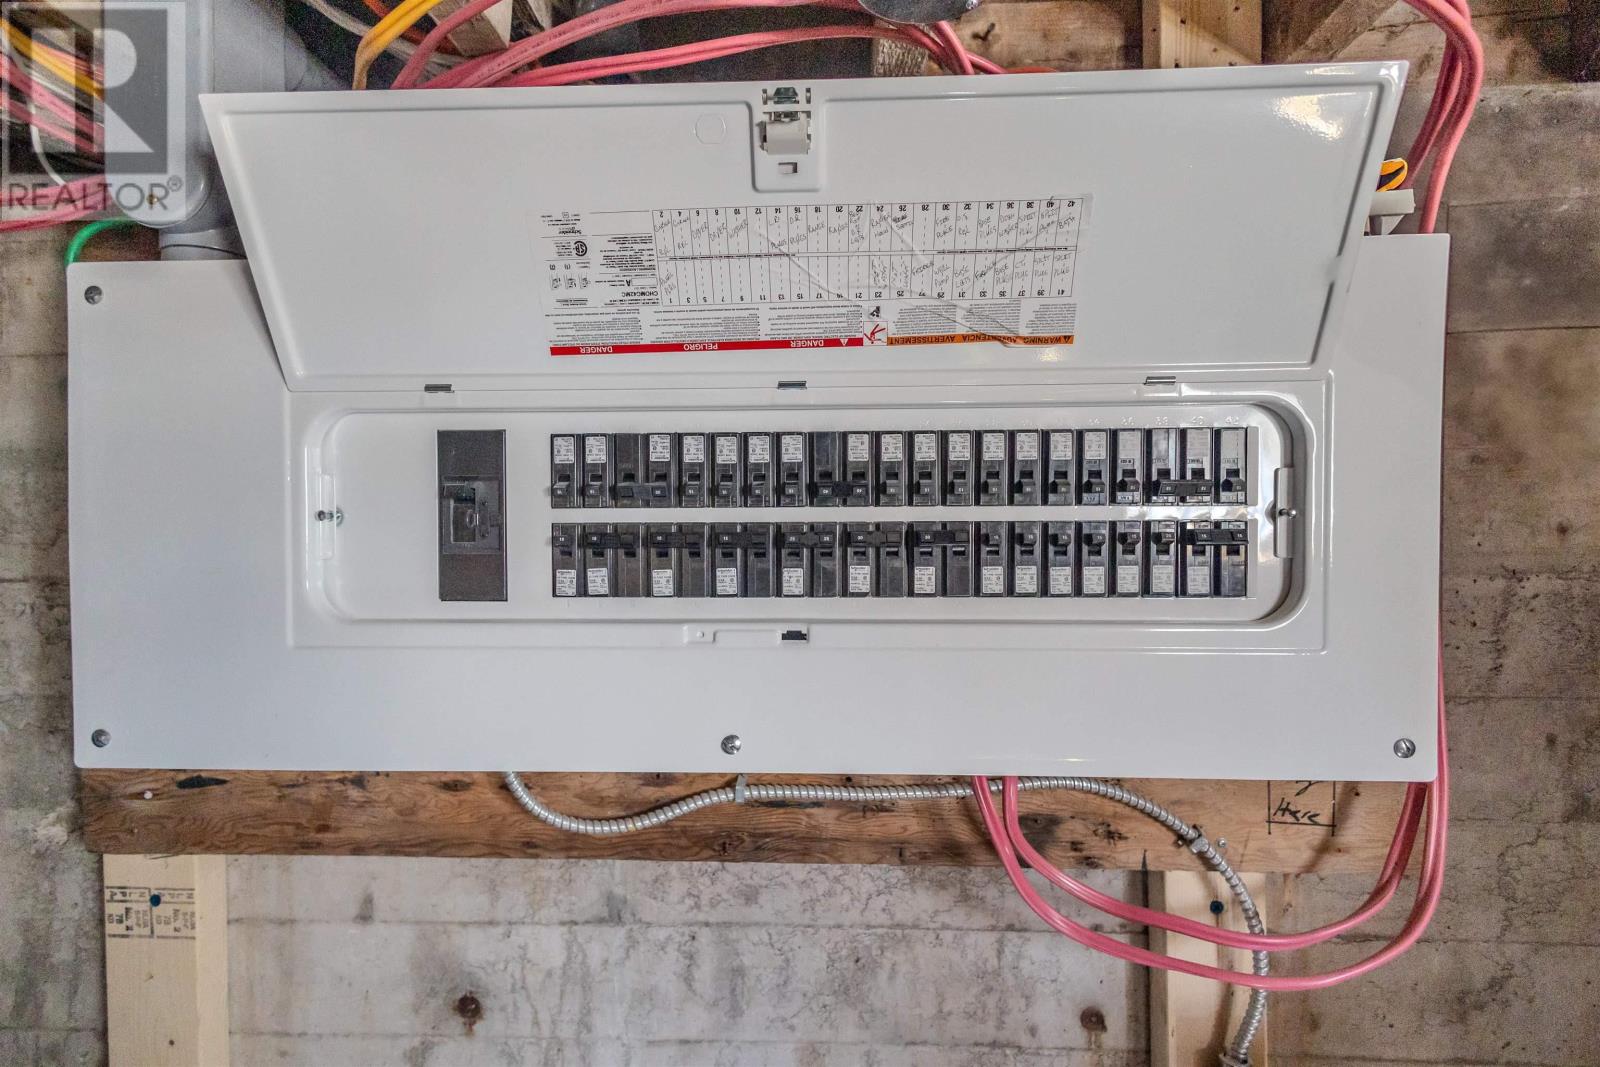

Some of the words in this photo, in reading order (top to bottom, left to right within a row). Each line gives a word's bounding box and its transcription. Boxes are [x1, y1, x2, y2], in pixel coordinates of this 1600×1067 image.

[889, 335, 956, 344] AVERTISSEMENT
[683, 343, 718, 351] PELIGRO
[790, 340, 824, 348] DANGER
